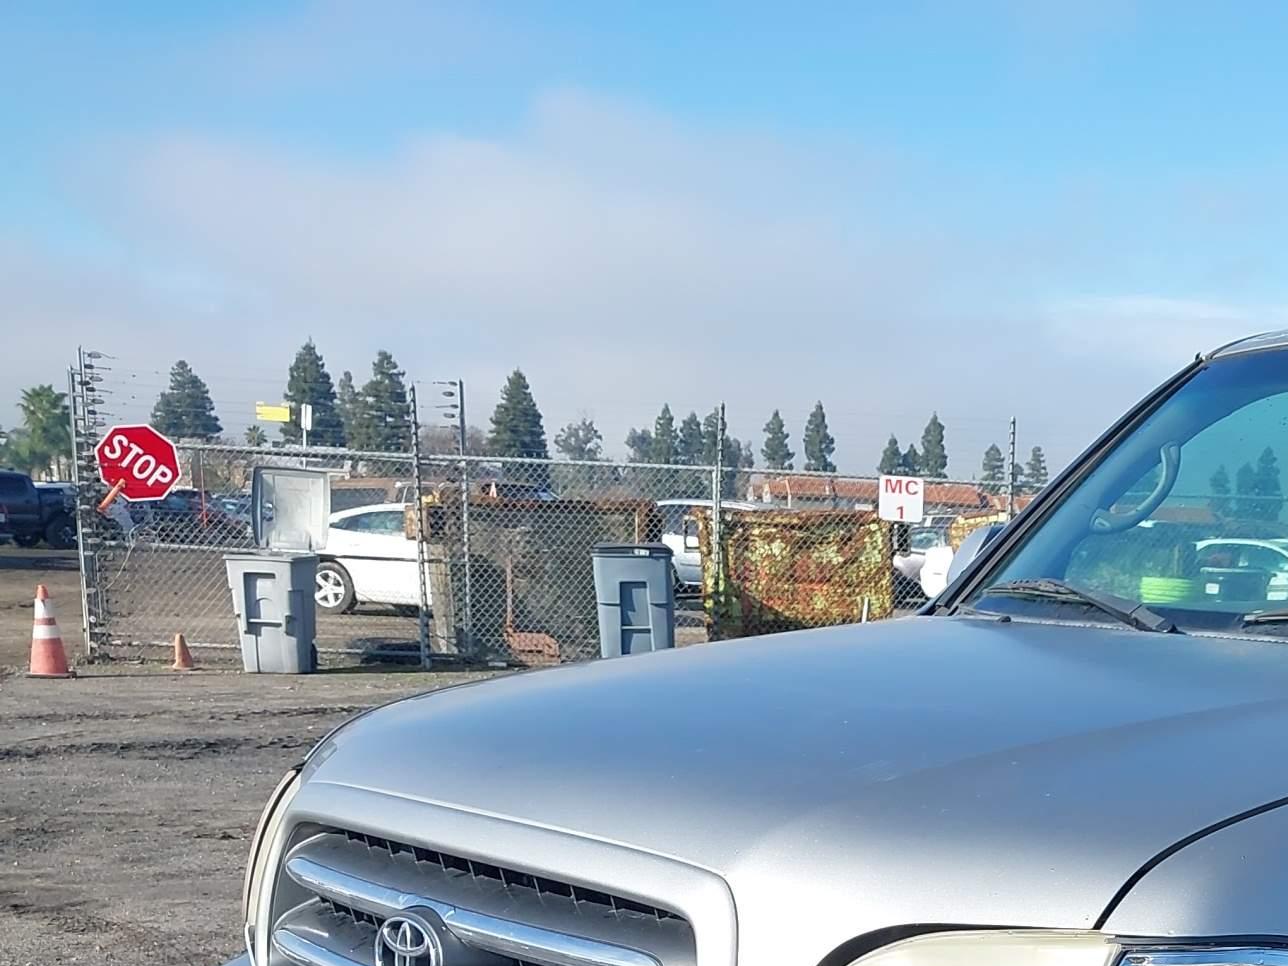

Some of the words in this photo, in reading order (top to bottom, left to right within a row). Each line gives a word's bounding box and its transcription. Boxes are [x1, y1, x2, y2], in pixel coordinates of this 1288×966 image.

[103, 434, 173, 487] STOP
[885, 479, 919, 495] MC
[896, 506, 904, 519] 1
